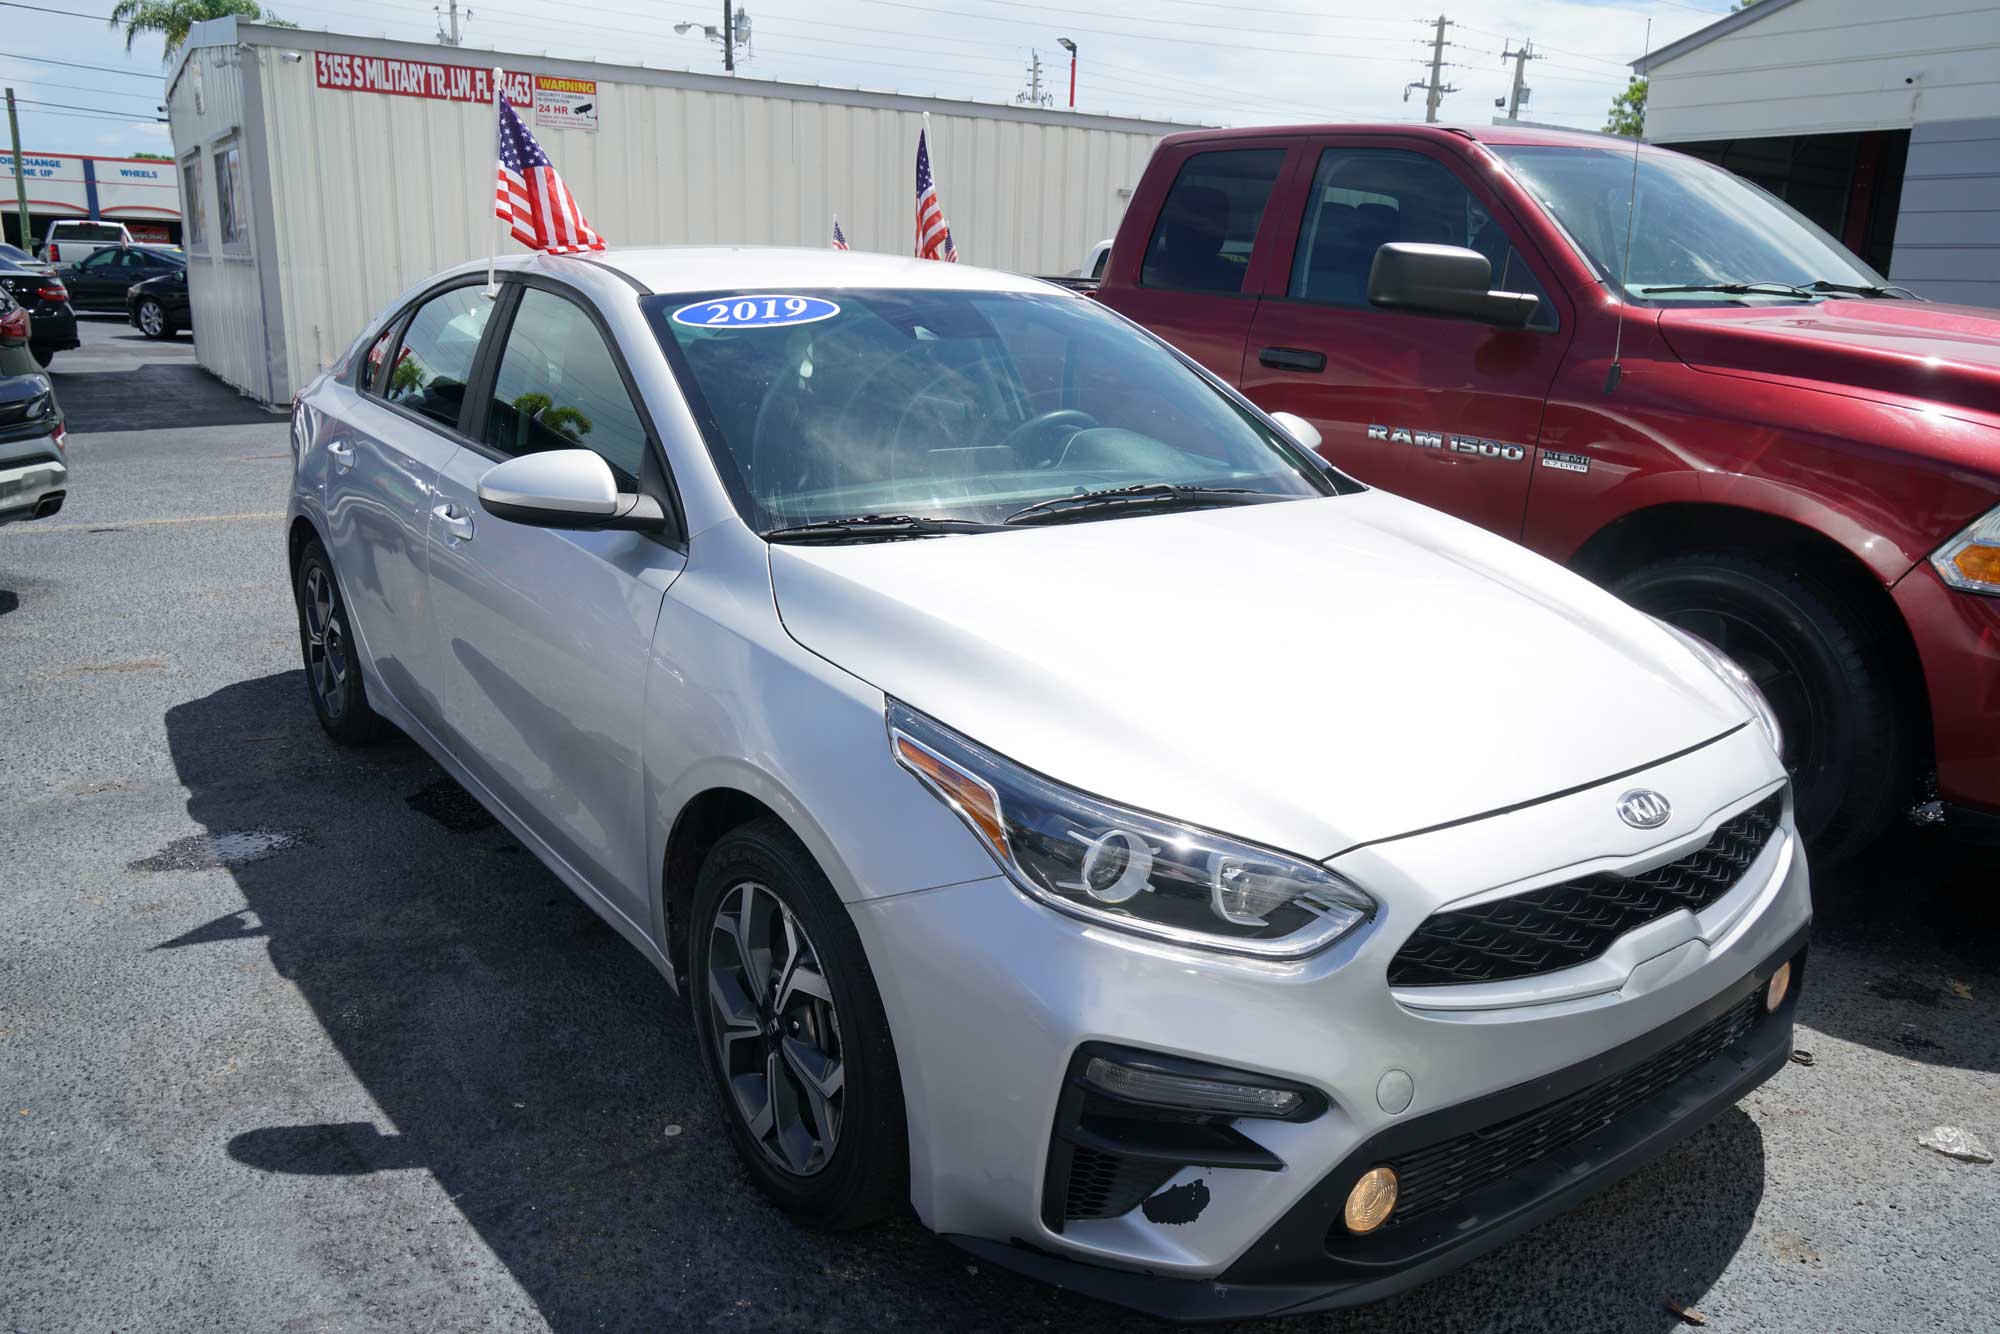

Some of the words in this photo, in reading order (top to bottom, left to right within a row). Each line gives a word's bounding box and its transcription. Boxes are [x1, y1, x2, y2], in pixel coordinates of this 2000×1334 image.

[318, 53, 352, 86] 3155
[353, 57, 364, 88] S
[365, 58, 426, 94] MILITARY
[475, 70, 491, 100] FL
[493, 73, 531, 104] 3463
[539, 78, 595, 94] WARNING
[538, 104, 551, 113] 24
[554, 105, 568, 115] HR
[9, 167, 36, 177] TNE
[40, 169, 54, 177] UP
[120, 169, 158, 179] WHEELS
[706, 298, 808, 324] 2019
[1368, 424, 1443, 449] RAM
[1450, 436, 1525, 462] 1500
[1543, 451, 1589, 465] HEMI
[1623, 793, 1669, 822] KIA
